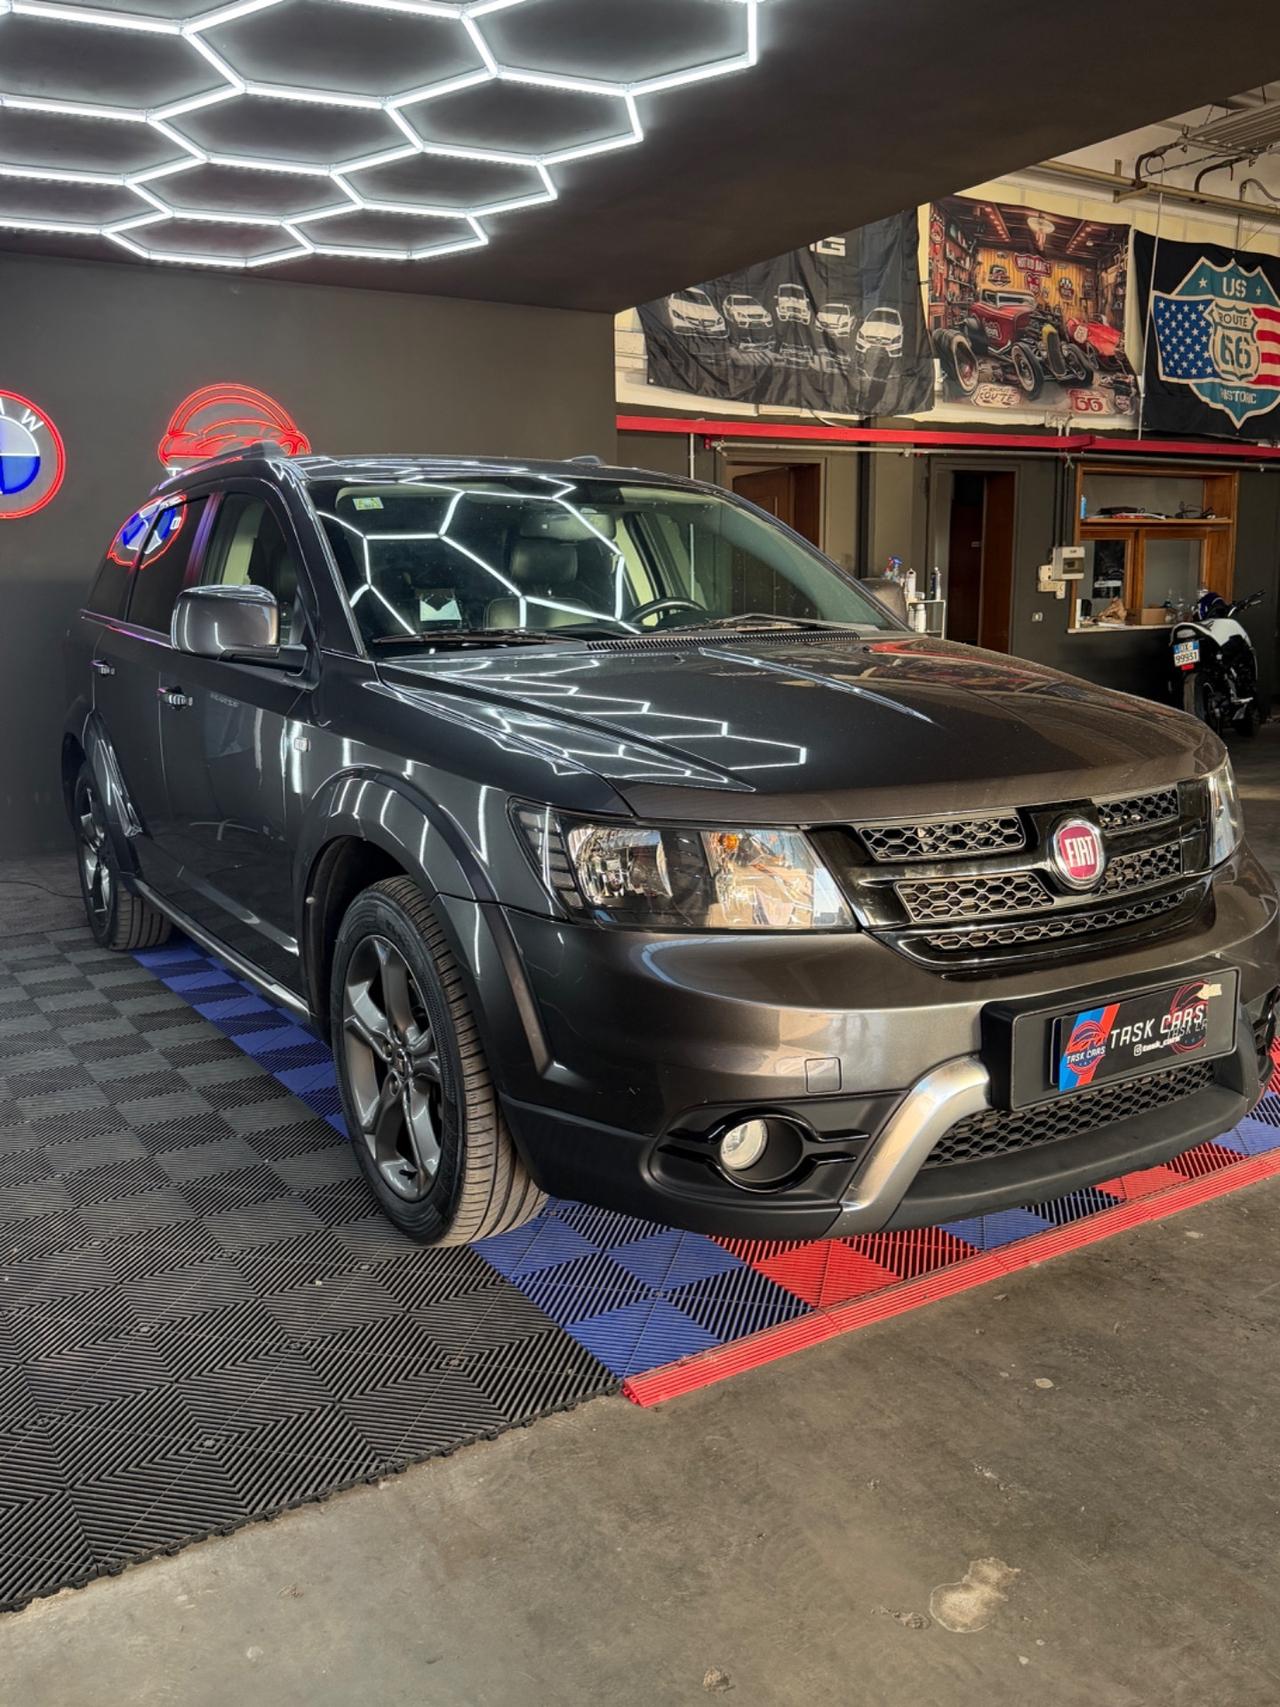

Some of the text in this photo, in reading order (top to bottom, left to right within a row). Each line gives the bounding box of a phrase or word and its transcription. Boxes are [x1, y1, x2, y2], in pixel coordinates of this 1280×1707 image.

[1222, 277, 1247, 298] US
[1218, 312, 1248, 328] ROUTE
[1220, 334, 1251, 369] 66
[1075, 397, 1104, 412] 66
[1064, 836, 1095, 867] FIAT
[1110, 1004, 1204, 1049] TASK CARS
[1066, 1045, 1106, 1064] TASK CARS
